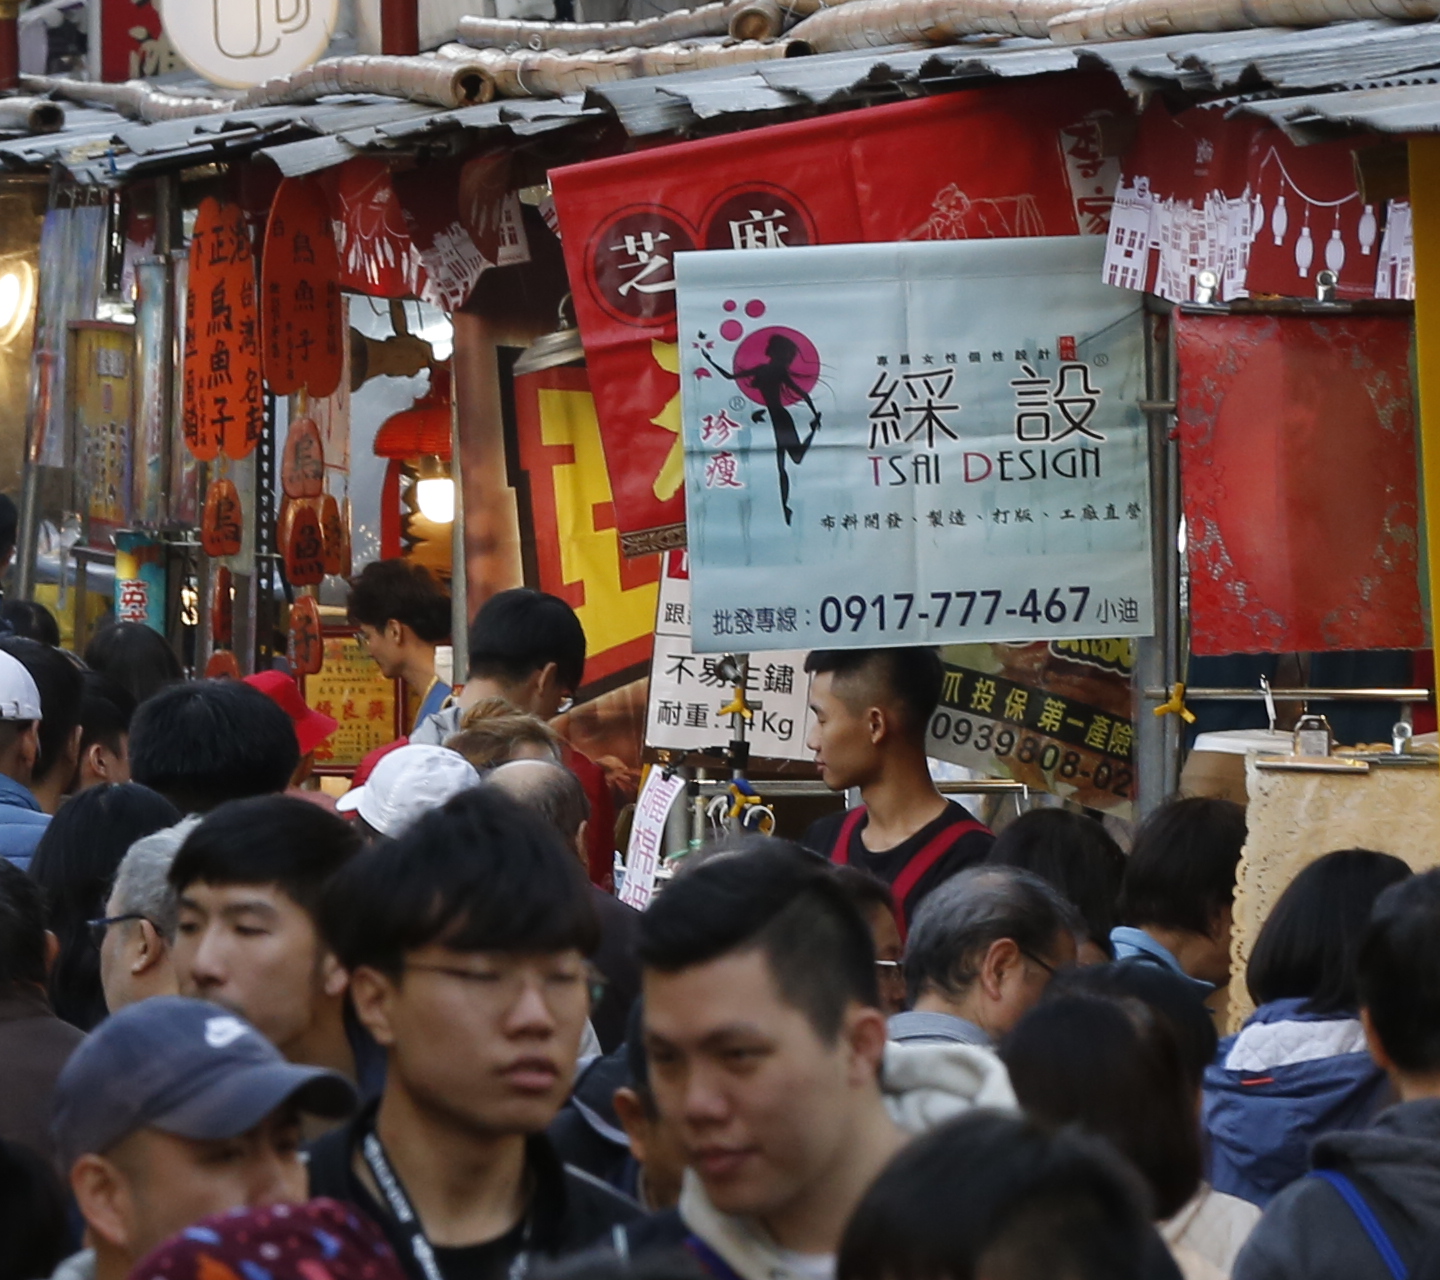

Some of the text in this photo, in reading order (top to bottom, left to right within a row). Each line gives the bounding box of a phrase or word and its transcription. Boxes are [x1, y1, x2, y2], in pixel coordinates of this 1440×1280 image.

[866, 446, 1102, 487] TSAI DESIGN
[819, 586, 1091, 634] 0917-777-467
[1094, 597, 1139, 624] 小迪
